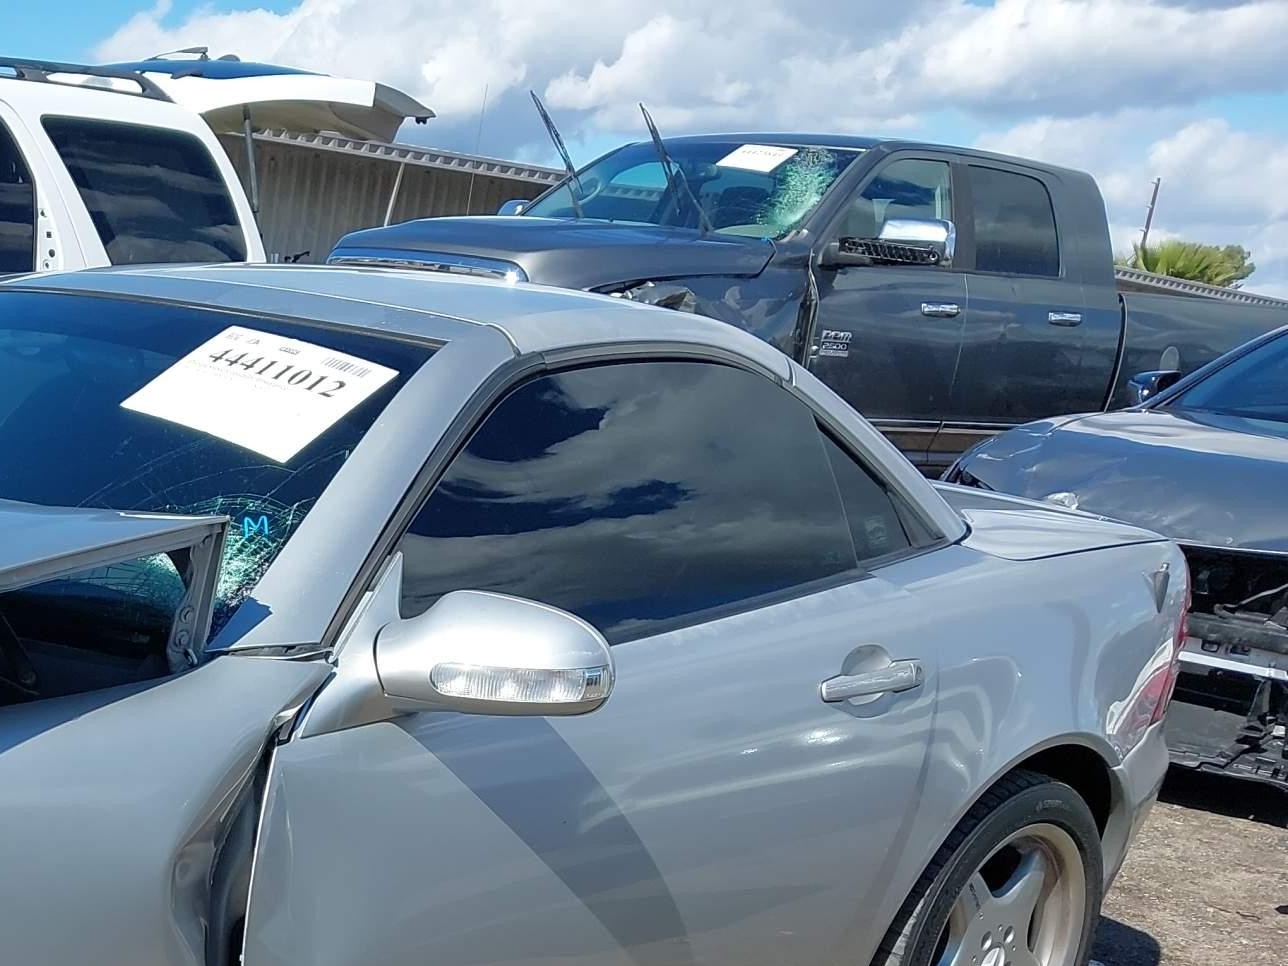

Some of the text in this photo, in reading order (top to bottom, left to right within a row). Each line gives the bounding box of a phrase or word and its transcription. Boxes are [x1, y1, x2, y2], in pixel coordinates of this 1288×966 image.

[822, 342, 848, 350] 2500
[209, 348, 347, 398] 44411012
[243, 515, 269, 538] M
